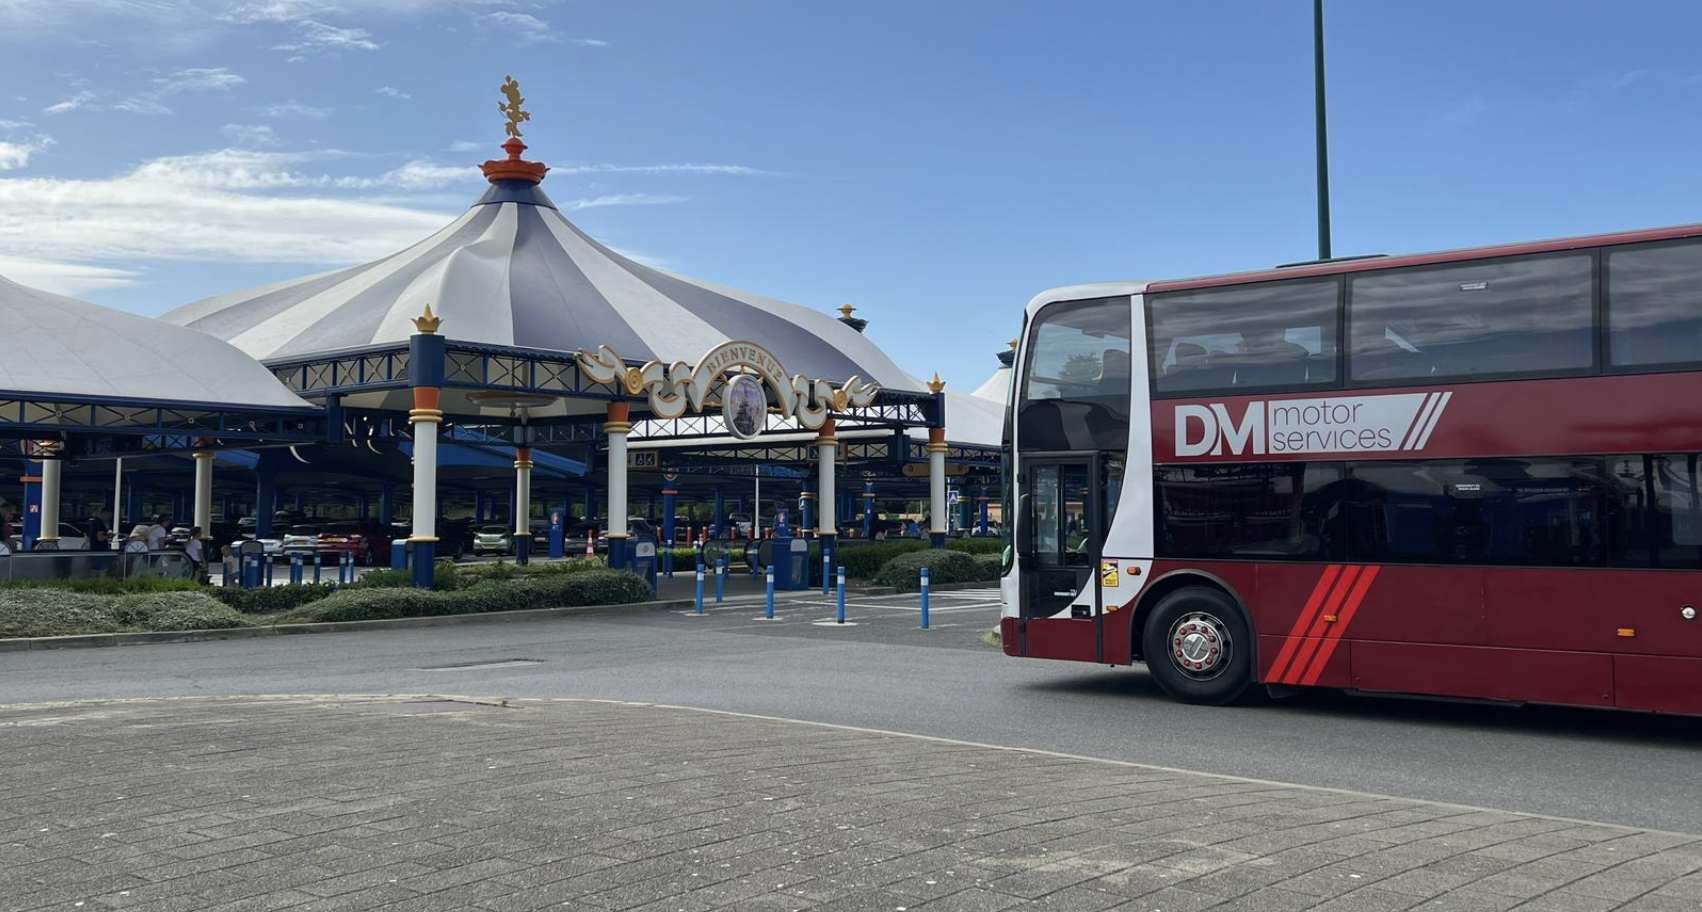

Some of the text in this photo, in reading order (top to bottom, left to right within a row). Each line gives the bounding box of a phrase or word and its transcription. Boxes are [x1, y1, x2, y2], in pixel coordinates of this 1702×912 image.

[706, 347, 783, 381] BIENVENUE
[1273, 401, 1364, 426] motor
[1174, 401, 1266, 457] DM
[1273, 428, 1392, 452] services
